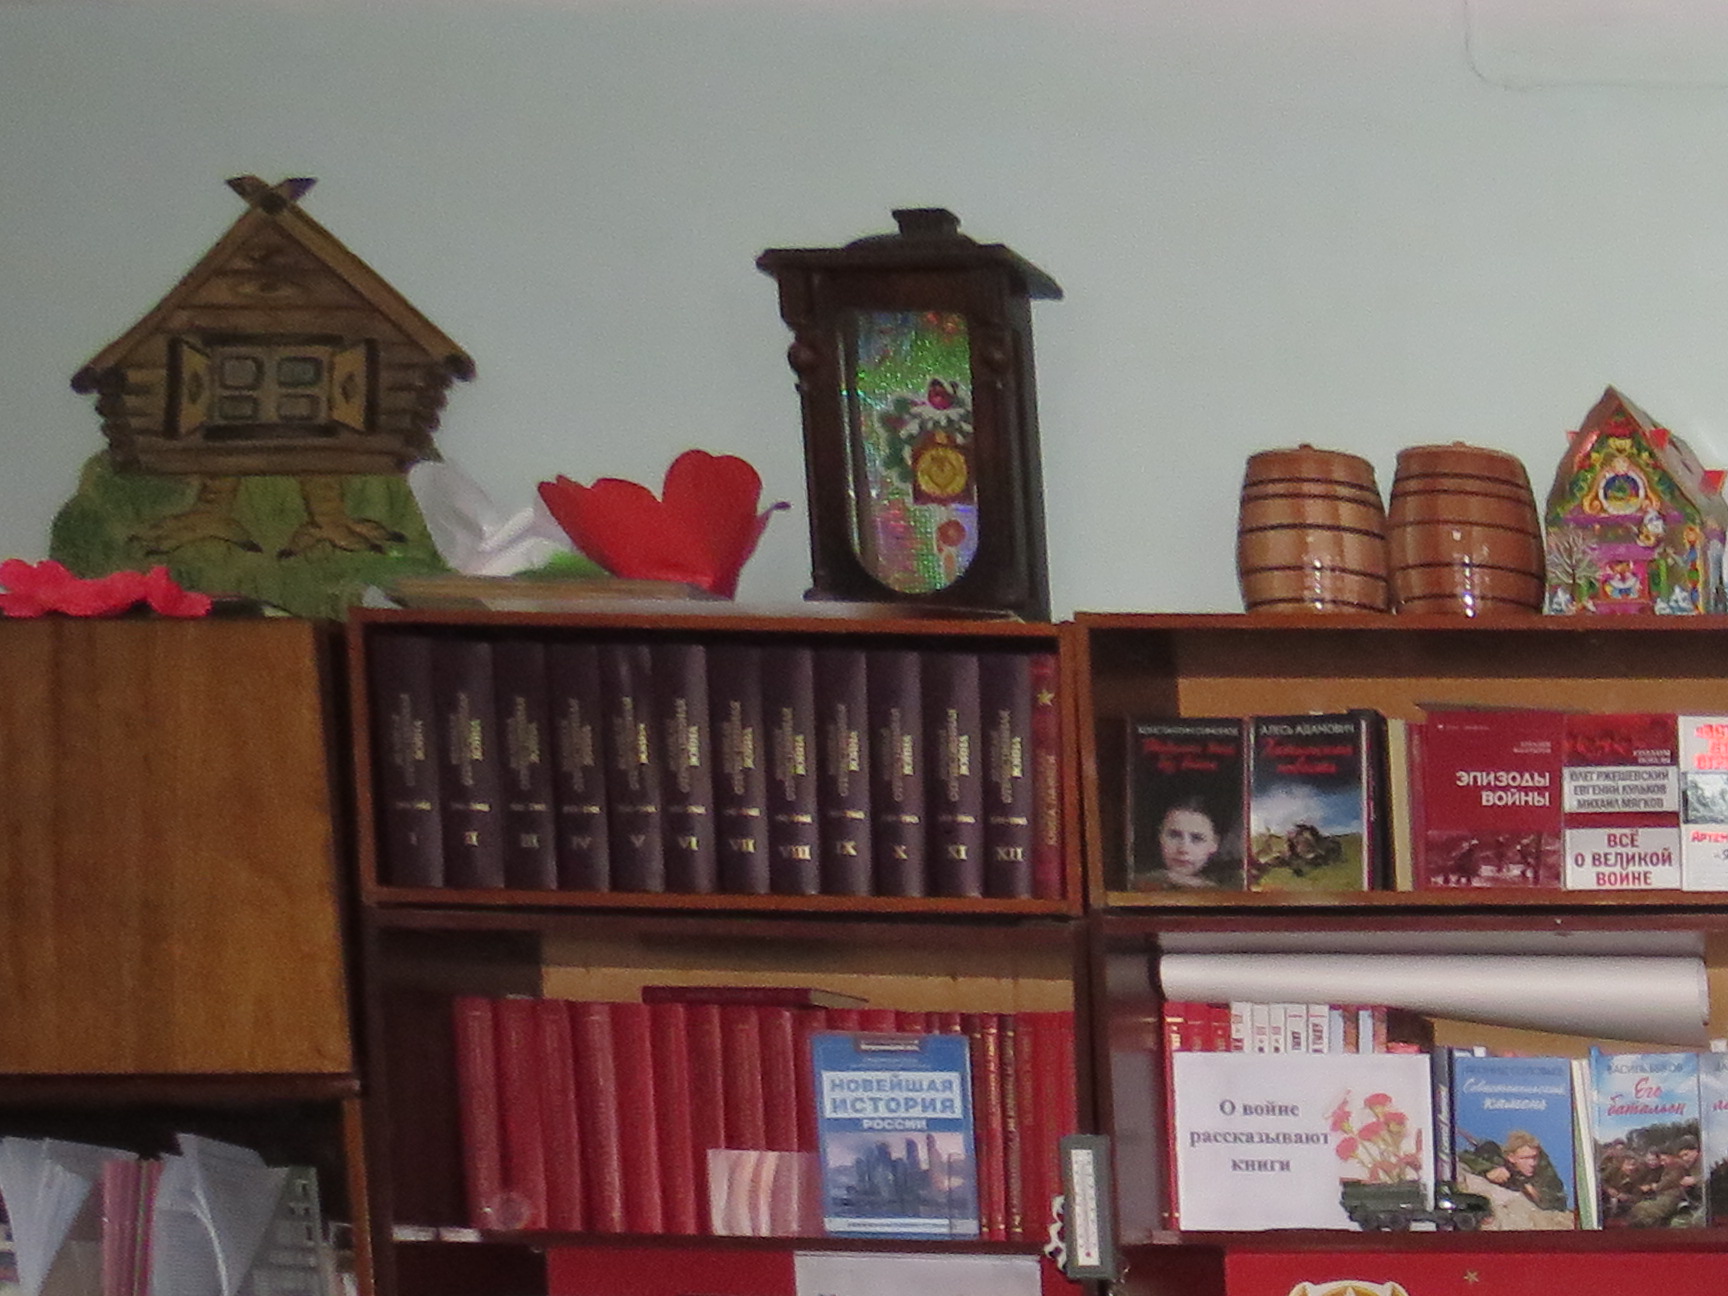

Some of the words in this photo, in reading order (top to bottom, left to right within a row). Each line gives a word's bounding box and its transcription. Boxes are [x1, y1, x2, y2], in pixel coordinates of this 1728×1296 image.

[1456, 771, 1550, 787] ЭПИЗОДЫ
[1570, 771, 1595, 783] ОЛЕГ
[1481, 788, 1550, 807] ВОЙНЫ
[1607, 828, 1639, 848] ВСЁ
[1574, 852, 1586, 868] О
[1591, 848, 1672, 869] ВЕЛИКОЙ
[1595, 868, 1652, 886] ВОЙНЕ
[831, 1077, 955, 1093] НОВЕЙШАЯ
[1634, 1077, 1664, 1099] Его
[832, 1097, 956, 1114] ИСТОРИЯ
[1219, 1099, 1236, 1117] О
[1242, 1099, 1300, 1117] войне
[1607, 1094, 1686, 1116] батальон
[863, 1118, 928, 1130] РОССИИ
[1189, 1130, 1330, 1148] рассказывают
[1231, 1158, 1292, 1173] книги
